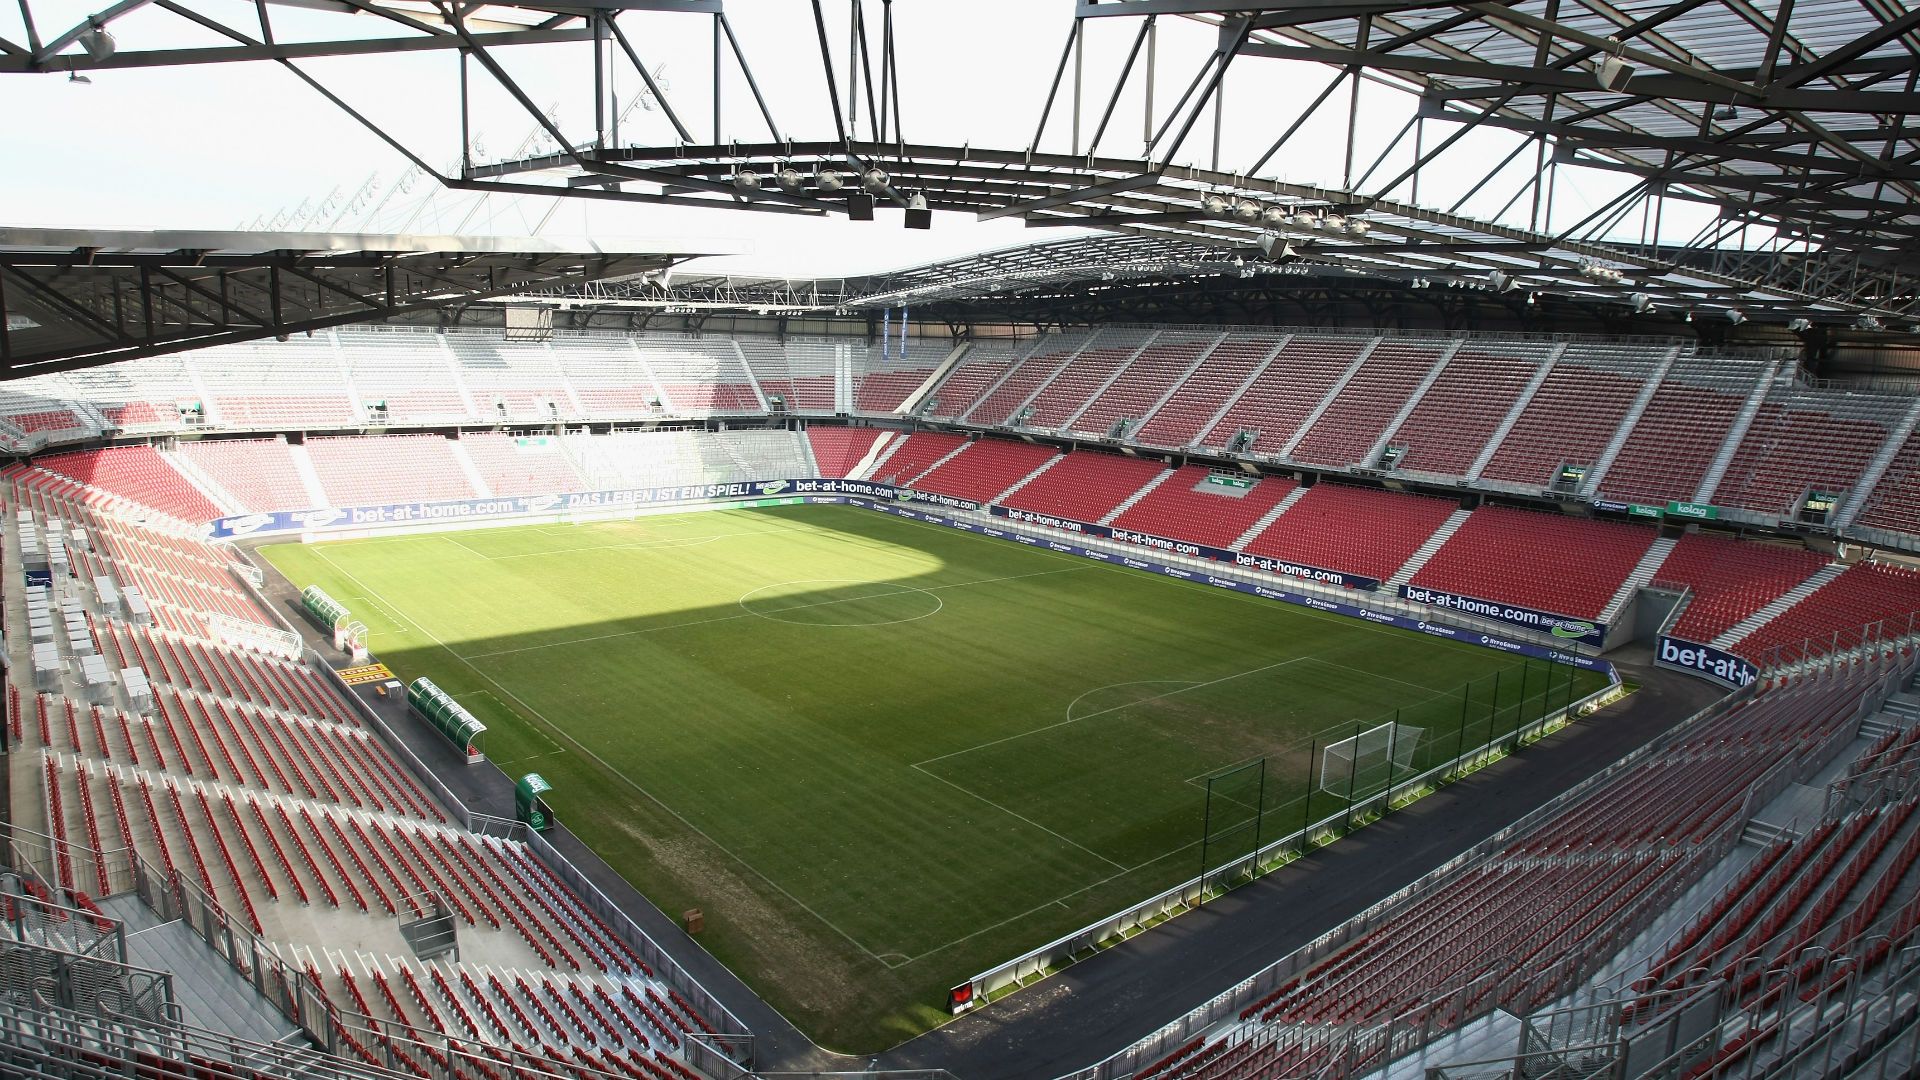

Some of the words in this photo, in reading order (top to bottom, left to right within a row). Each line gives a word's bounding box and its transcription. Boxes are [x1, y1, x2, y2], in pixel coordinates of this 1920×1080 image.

[569, 493, 601, 507] DAS
[604, 490, 653, 505] LEBEN
[655, 488, 679, 502] IST
[681, 486, 705, 499] EIN
[707, 483, 751, 497] SPIEL!
[796, 480, 893, 498] bet-at-home.com
[916, 490, 977, 511] bet-at-home.com
[352, 500, 513, 523] bet-at-home.com
[1008, 508, 1082, 532] bet-at-home.com
[1677, 502, 1707, 517] kelag
[1111, 528, 1199, 555] bet-at-home.com
[1236, 552, 1343, 584] bet-at-home.com
[1406, 586, 1539, 624] bet-at-home.com
